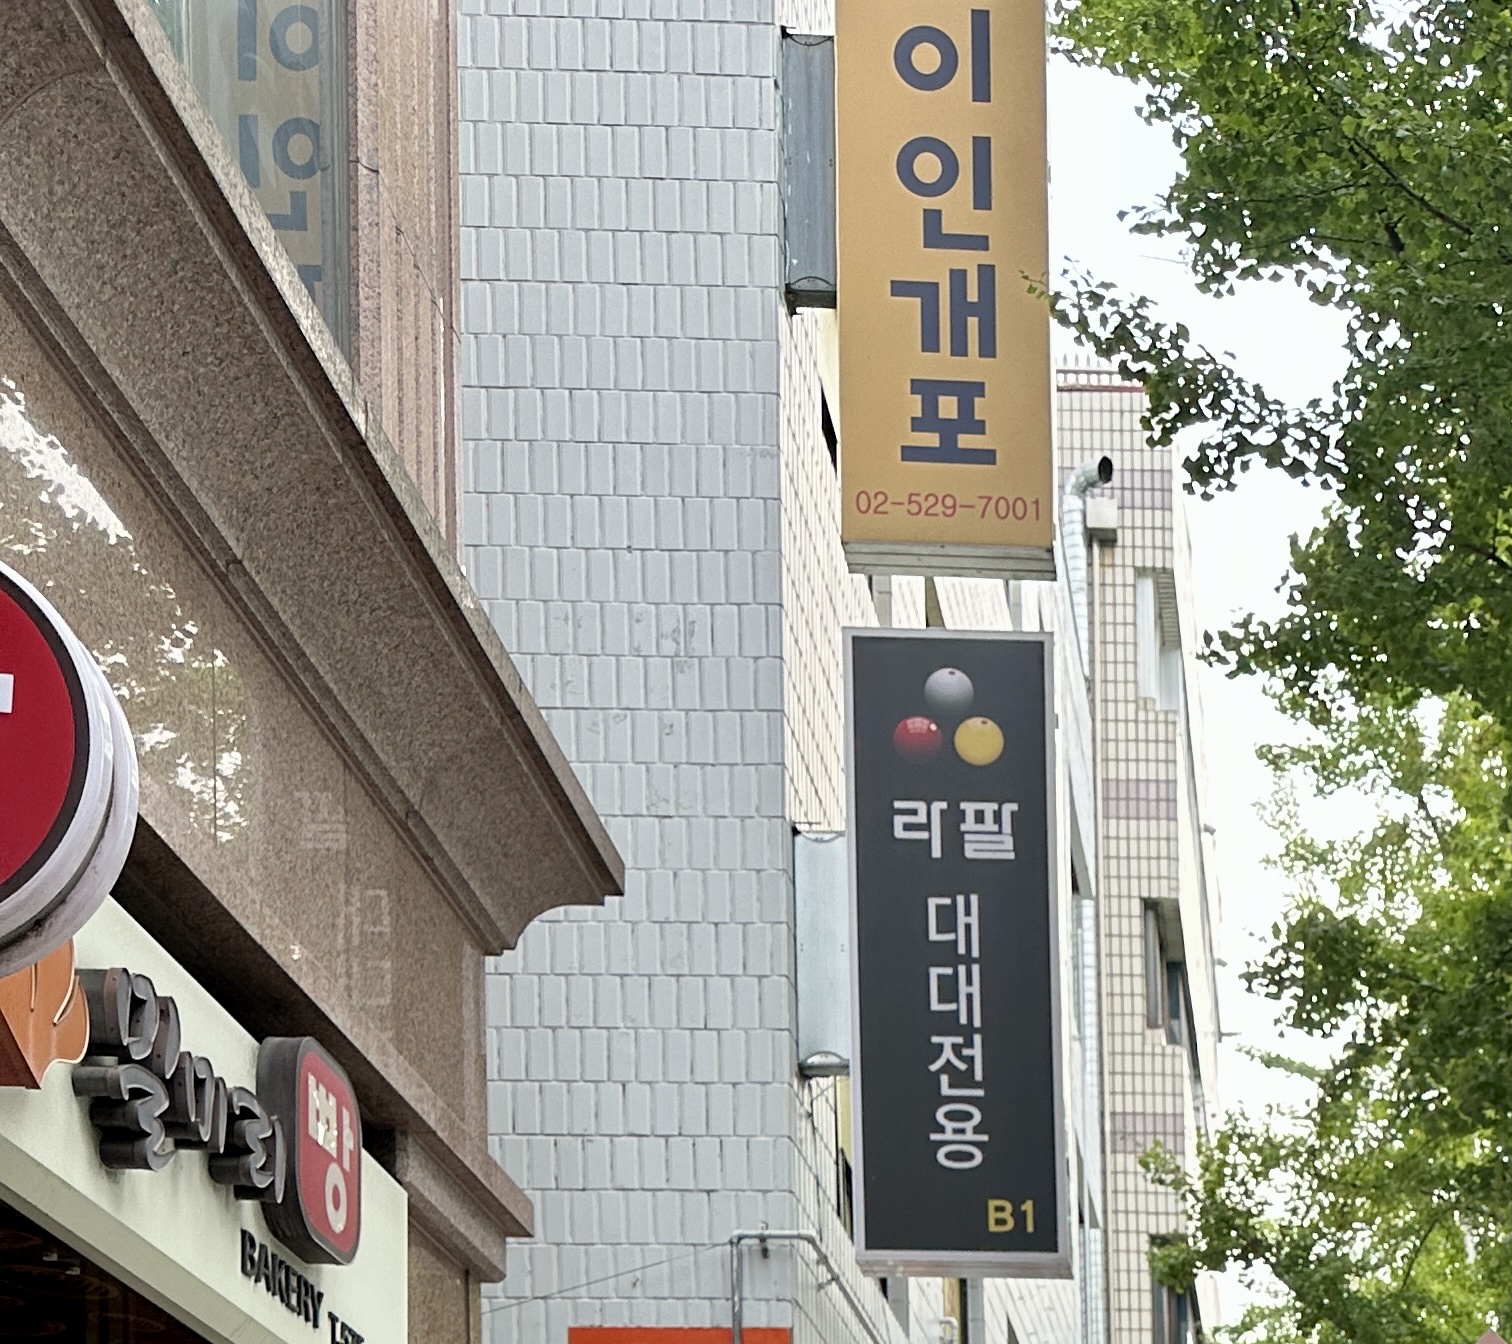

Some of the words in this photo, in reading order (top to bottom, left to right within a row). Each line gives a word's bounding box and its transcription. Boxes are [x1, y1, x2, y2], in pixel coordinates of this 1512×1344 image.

[889, 8, 998, 466] 이인개포
[855, 490, 1041, 521] 02-529-7001
[893, 799, 1019, 860] 라팔
[926, 893, 990, 1170] 대대전용
[986, 1198, 1037, 1233] B1
[240, 1228, 325, 1329] BAKERY
